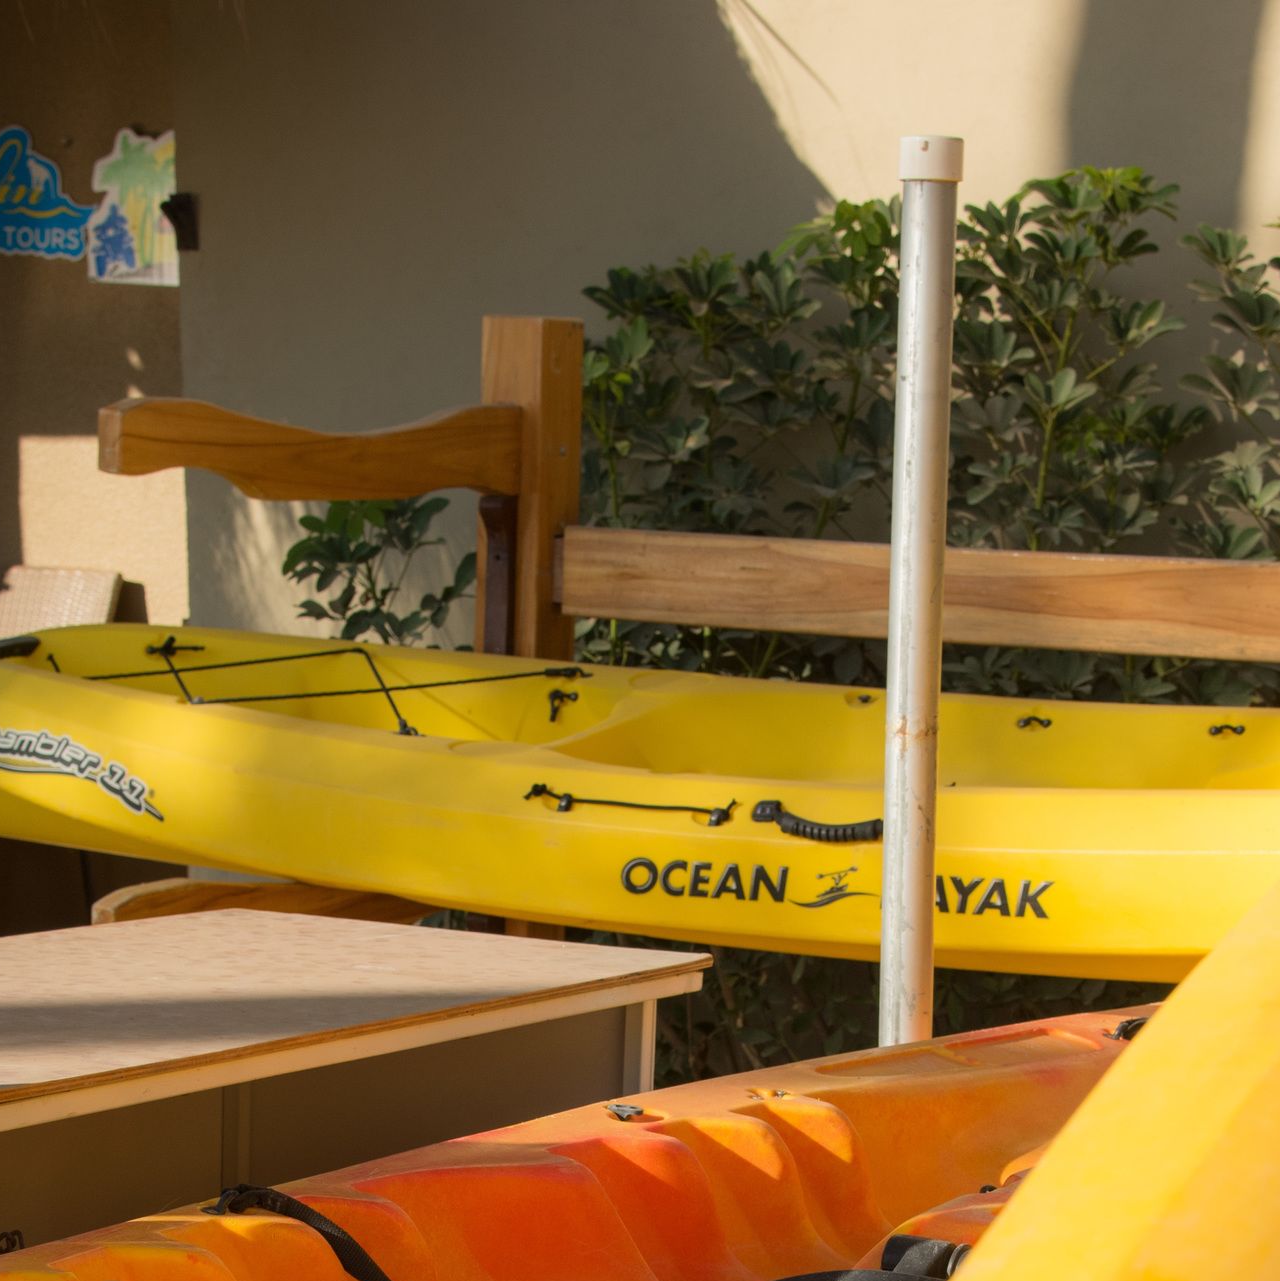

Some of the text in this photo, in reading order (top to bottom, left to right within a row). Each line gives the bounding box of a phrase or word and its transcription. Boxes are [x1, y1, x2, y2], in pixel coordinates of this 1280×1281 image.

[3, 225, 81, 250] TOURS
[620, 857, 1056, 920] OCEAN YAK
